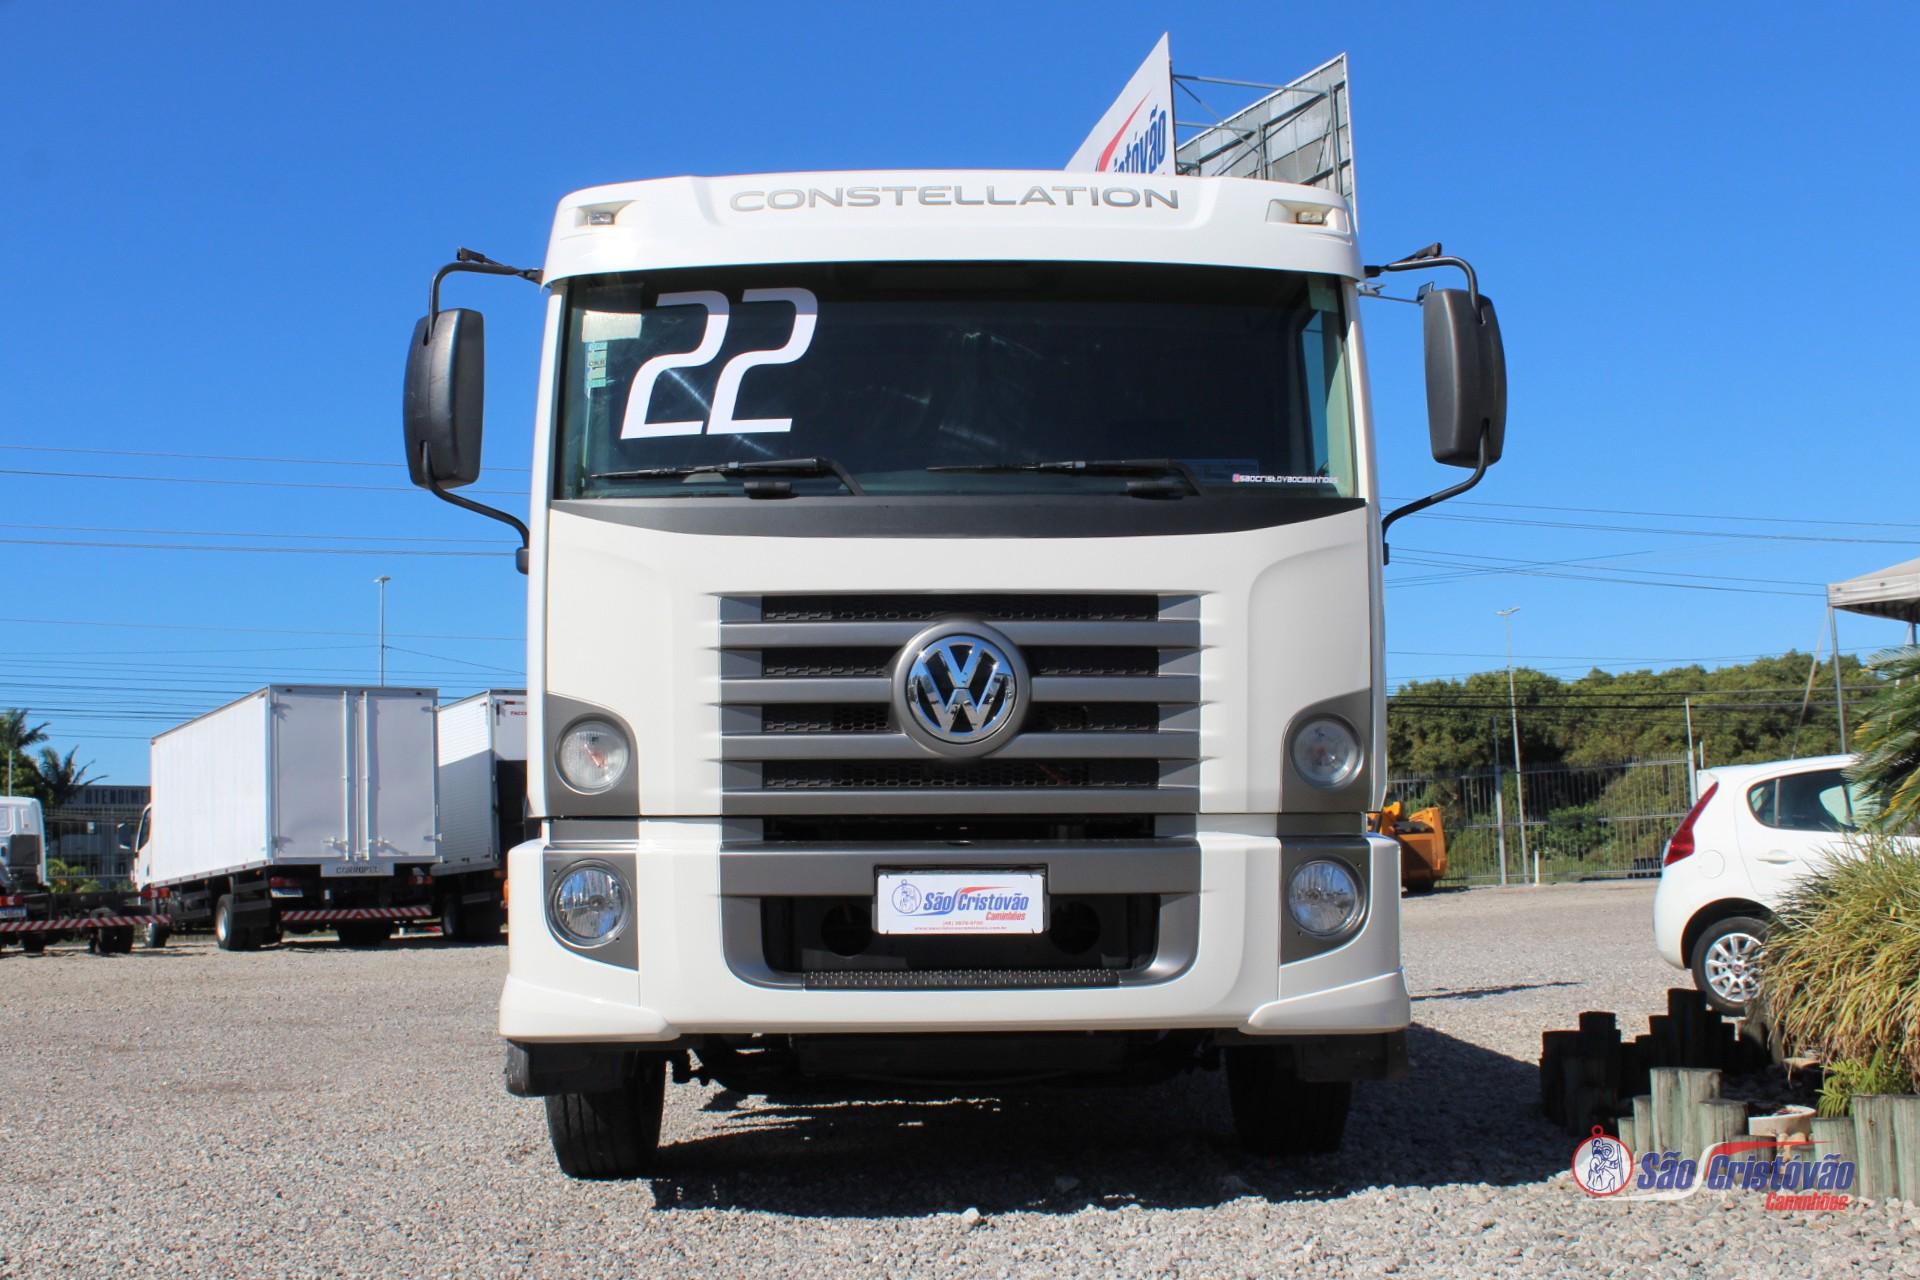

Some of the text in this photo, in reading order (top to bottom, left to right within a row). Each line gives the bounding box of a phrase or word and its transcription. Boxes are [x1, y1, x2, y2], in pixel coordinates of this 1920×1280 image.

[730, 185, 1180, 211] CONSTELLATION
[620, 287, 818, 439] 22
[923, 892, 1029, 911] São Cristóvão
